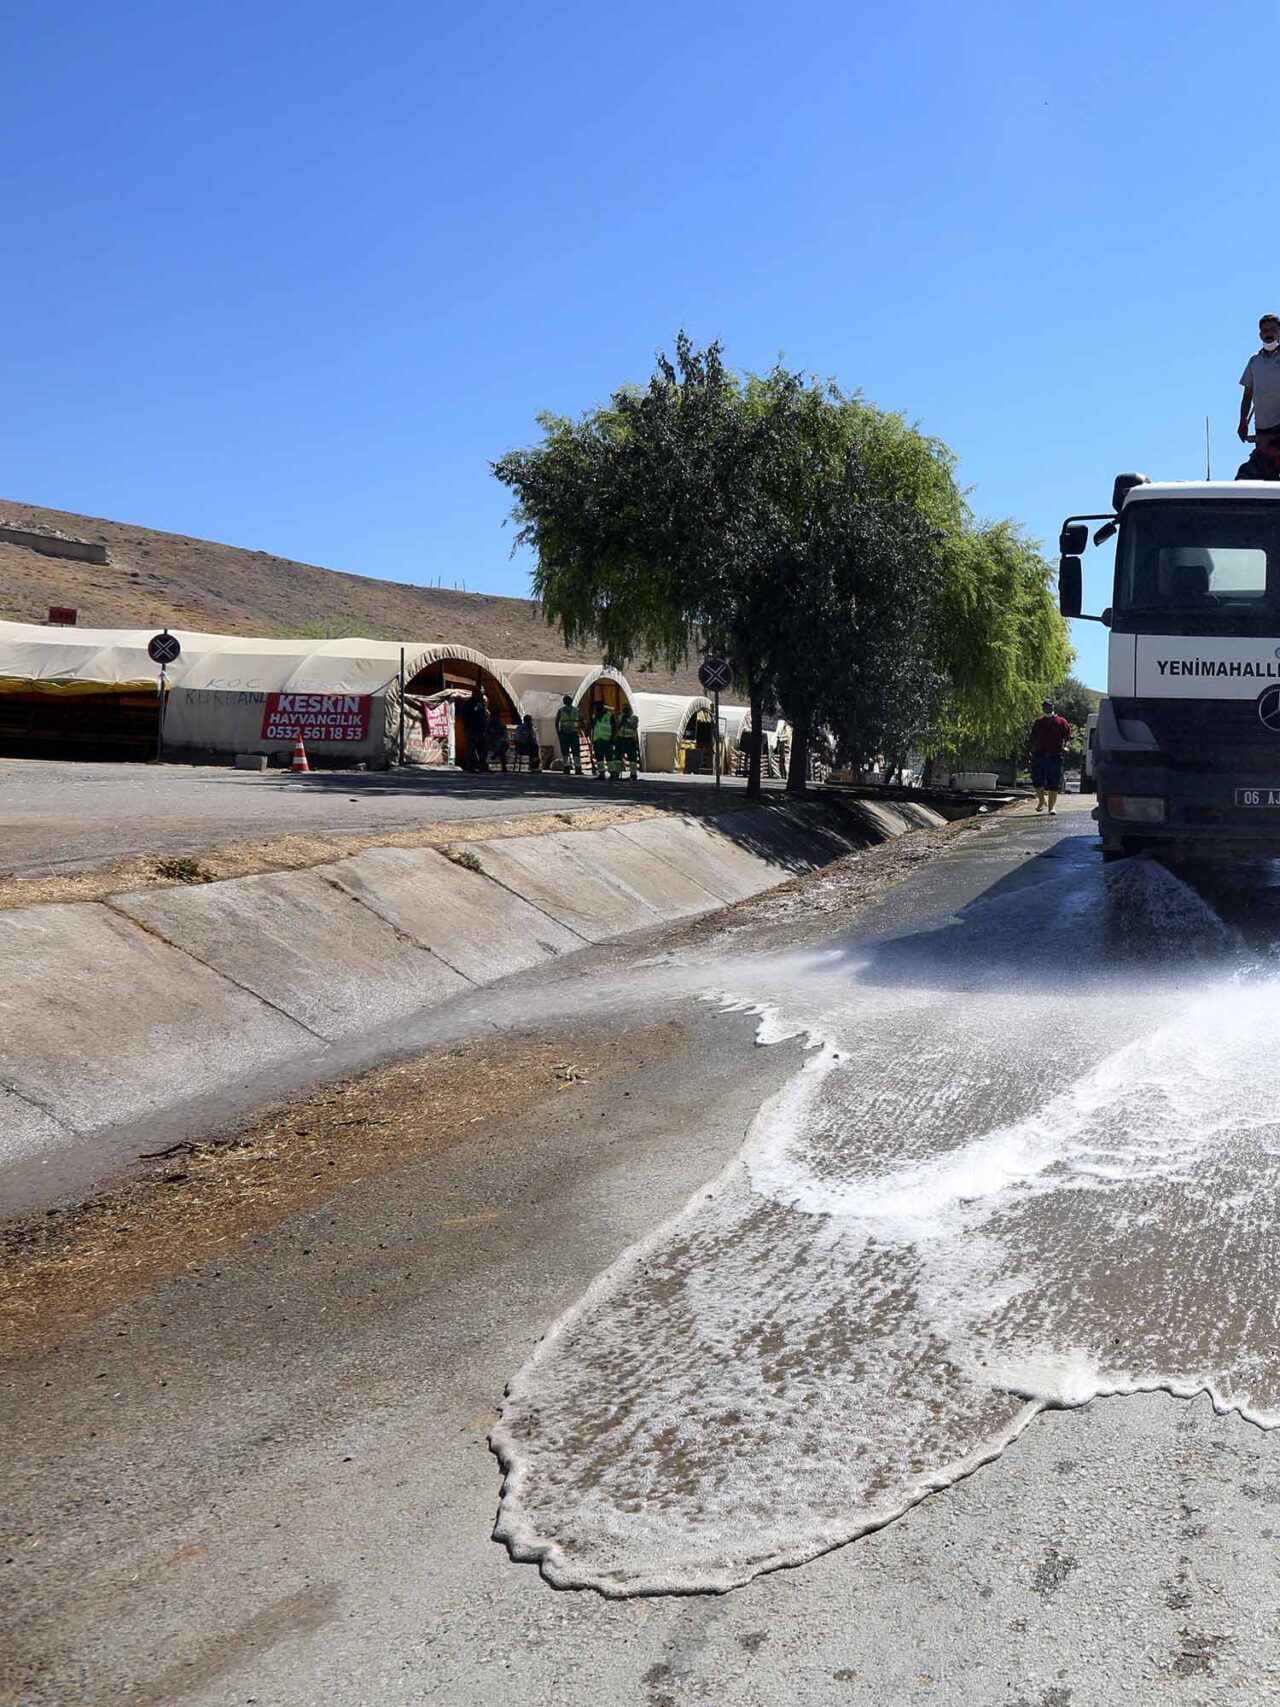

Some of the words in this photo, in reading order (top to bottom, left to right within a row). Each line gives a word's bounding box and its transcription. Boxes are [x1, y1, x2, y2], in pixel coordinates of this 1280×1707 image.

[270, 713, 362, 726] HAYVANCILIK
[267, 726, 301, 738] 0532
[303, 727, 326, 739] 561
[330, 727, 343, 739] 18
[346, 727, 363, 740] 53
[1244, 791, 1260, 805] 06
